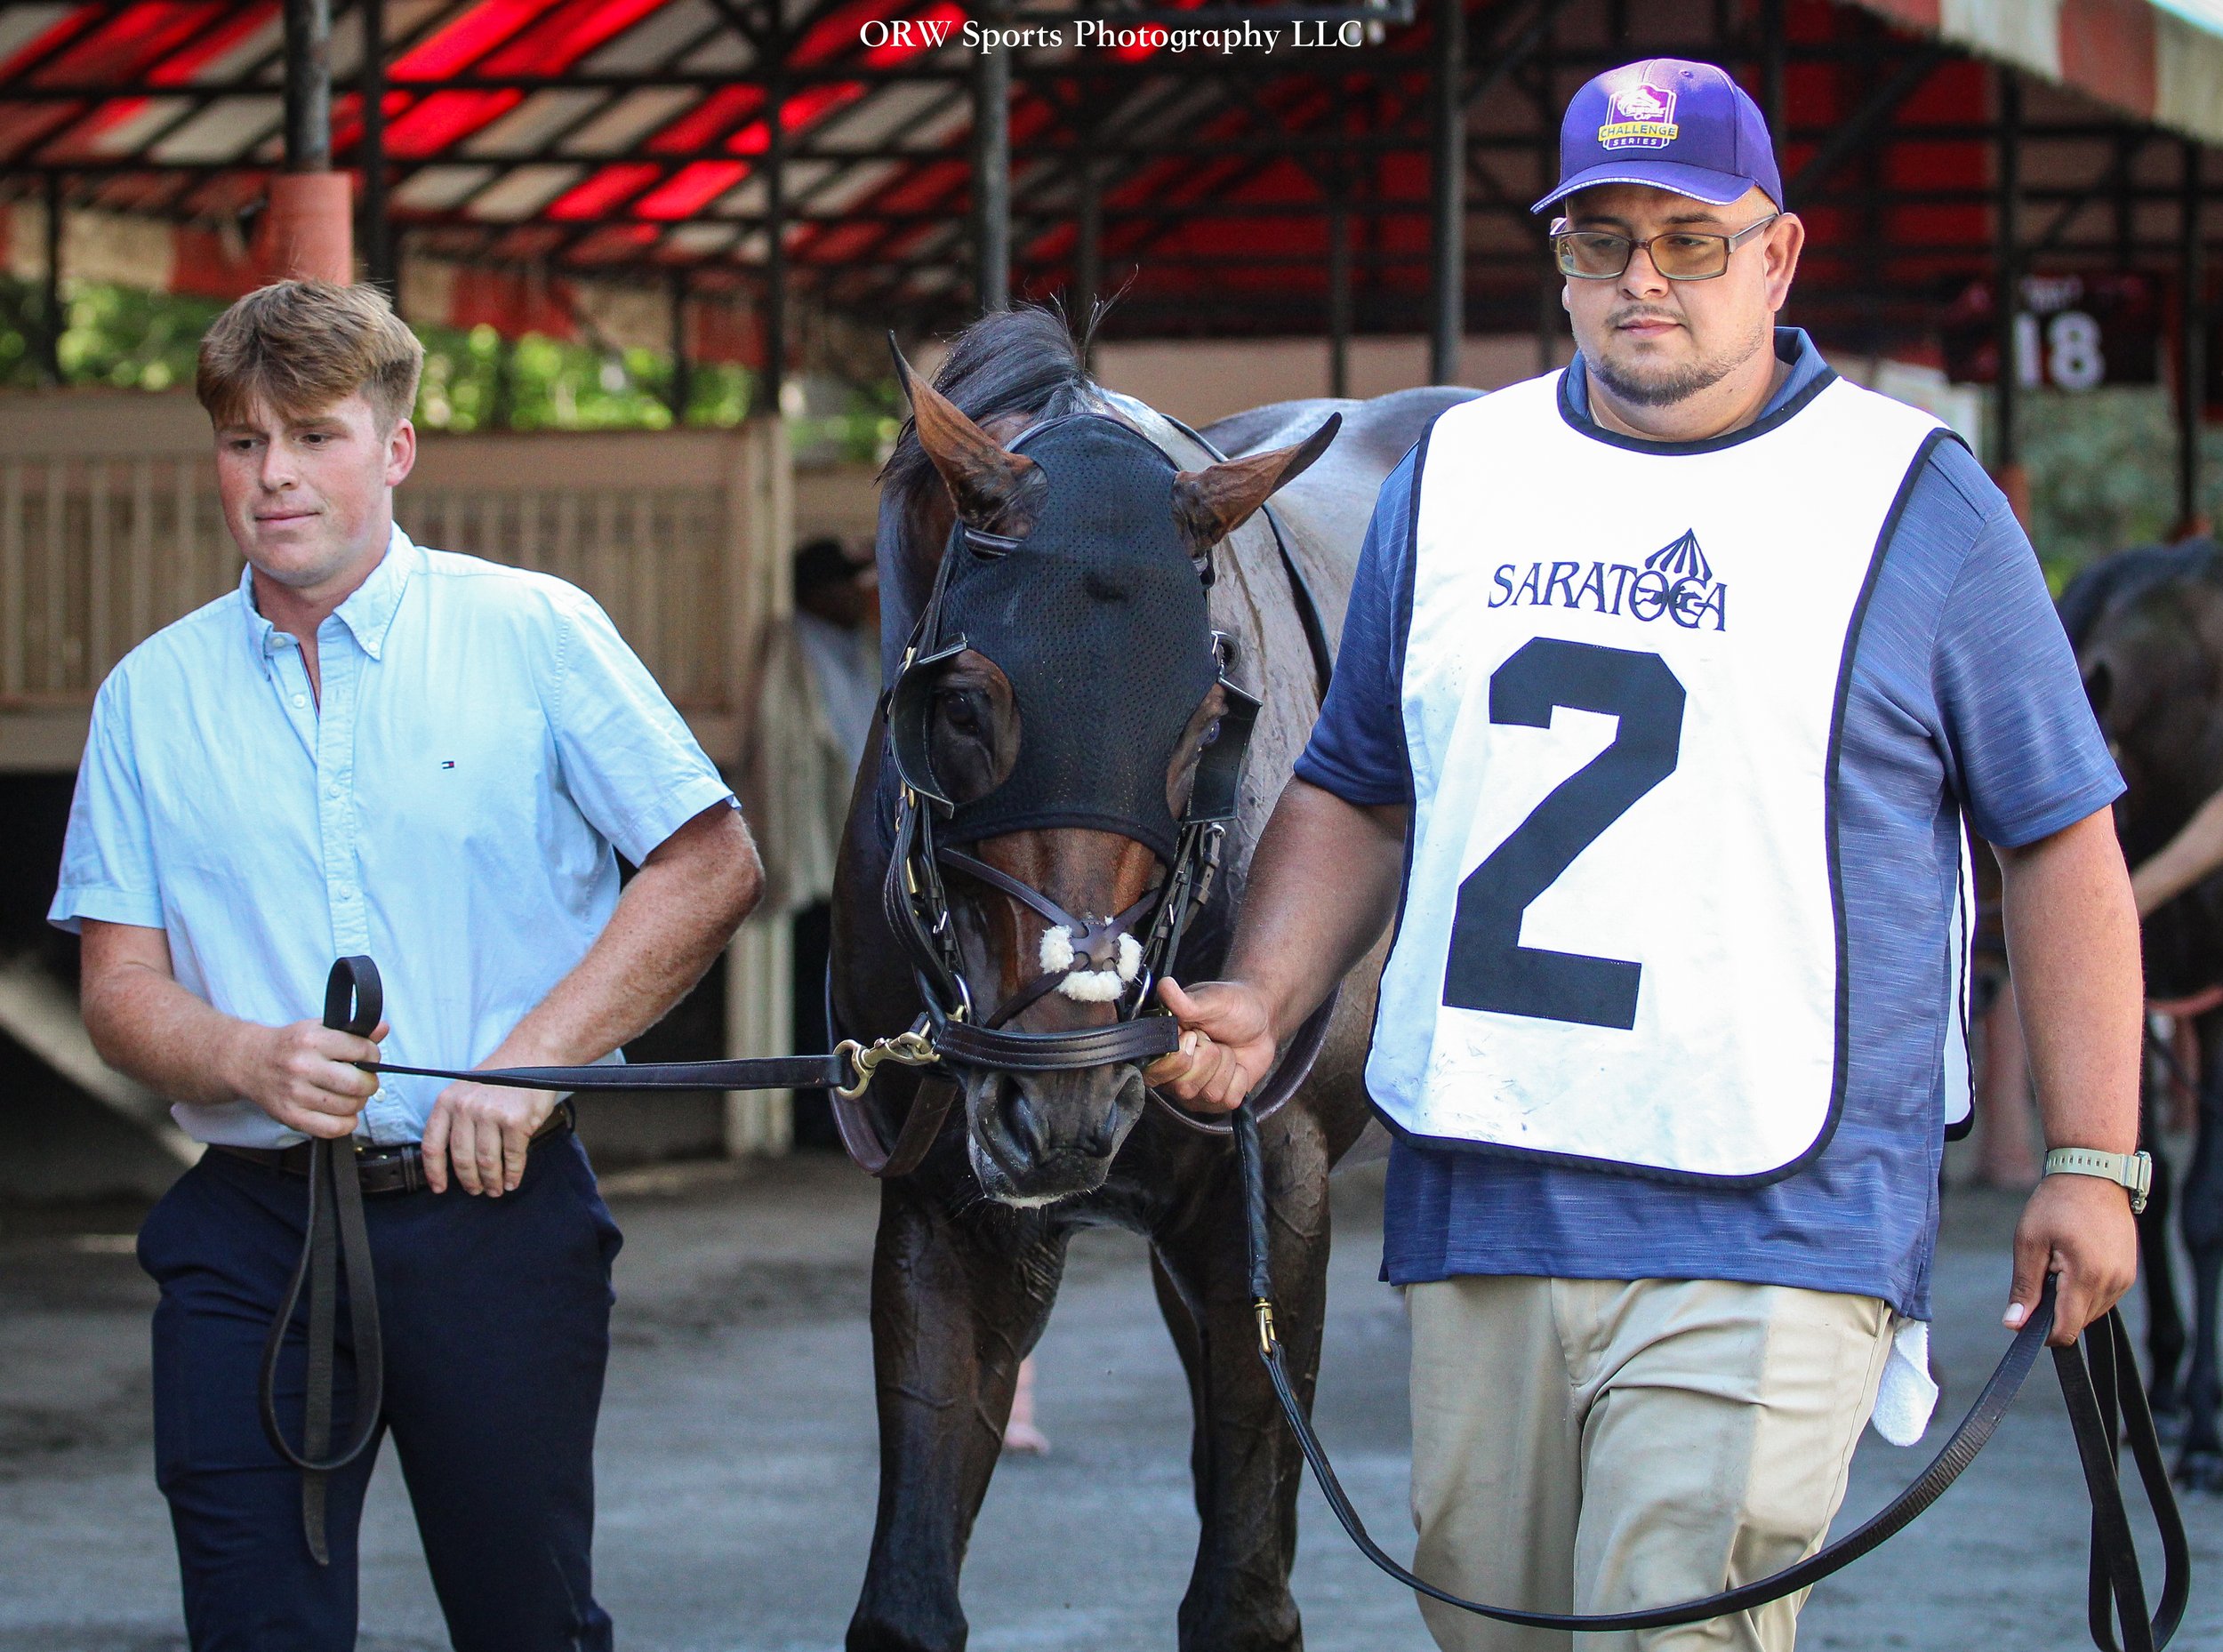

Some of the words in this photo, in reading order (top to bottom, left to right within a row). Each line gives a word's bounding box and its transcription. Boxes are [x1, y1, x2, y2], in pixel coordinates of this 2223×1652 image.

[1601, 124, 1676, 138] CHALLENGE
[1612, 137, 1657, 147] SERIES
[2012, 311, 2105, 390] 18
[1487, 560, 1728, 632] SARATOGA
[1441, 636, 1688, 1031] 2
